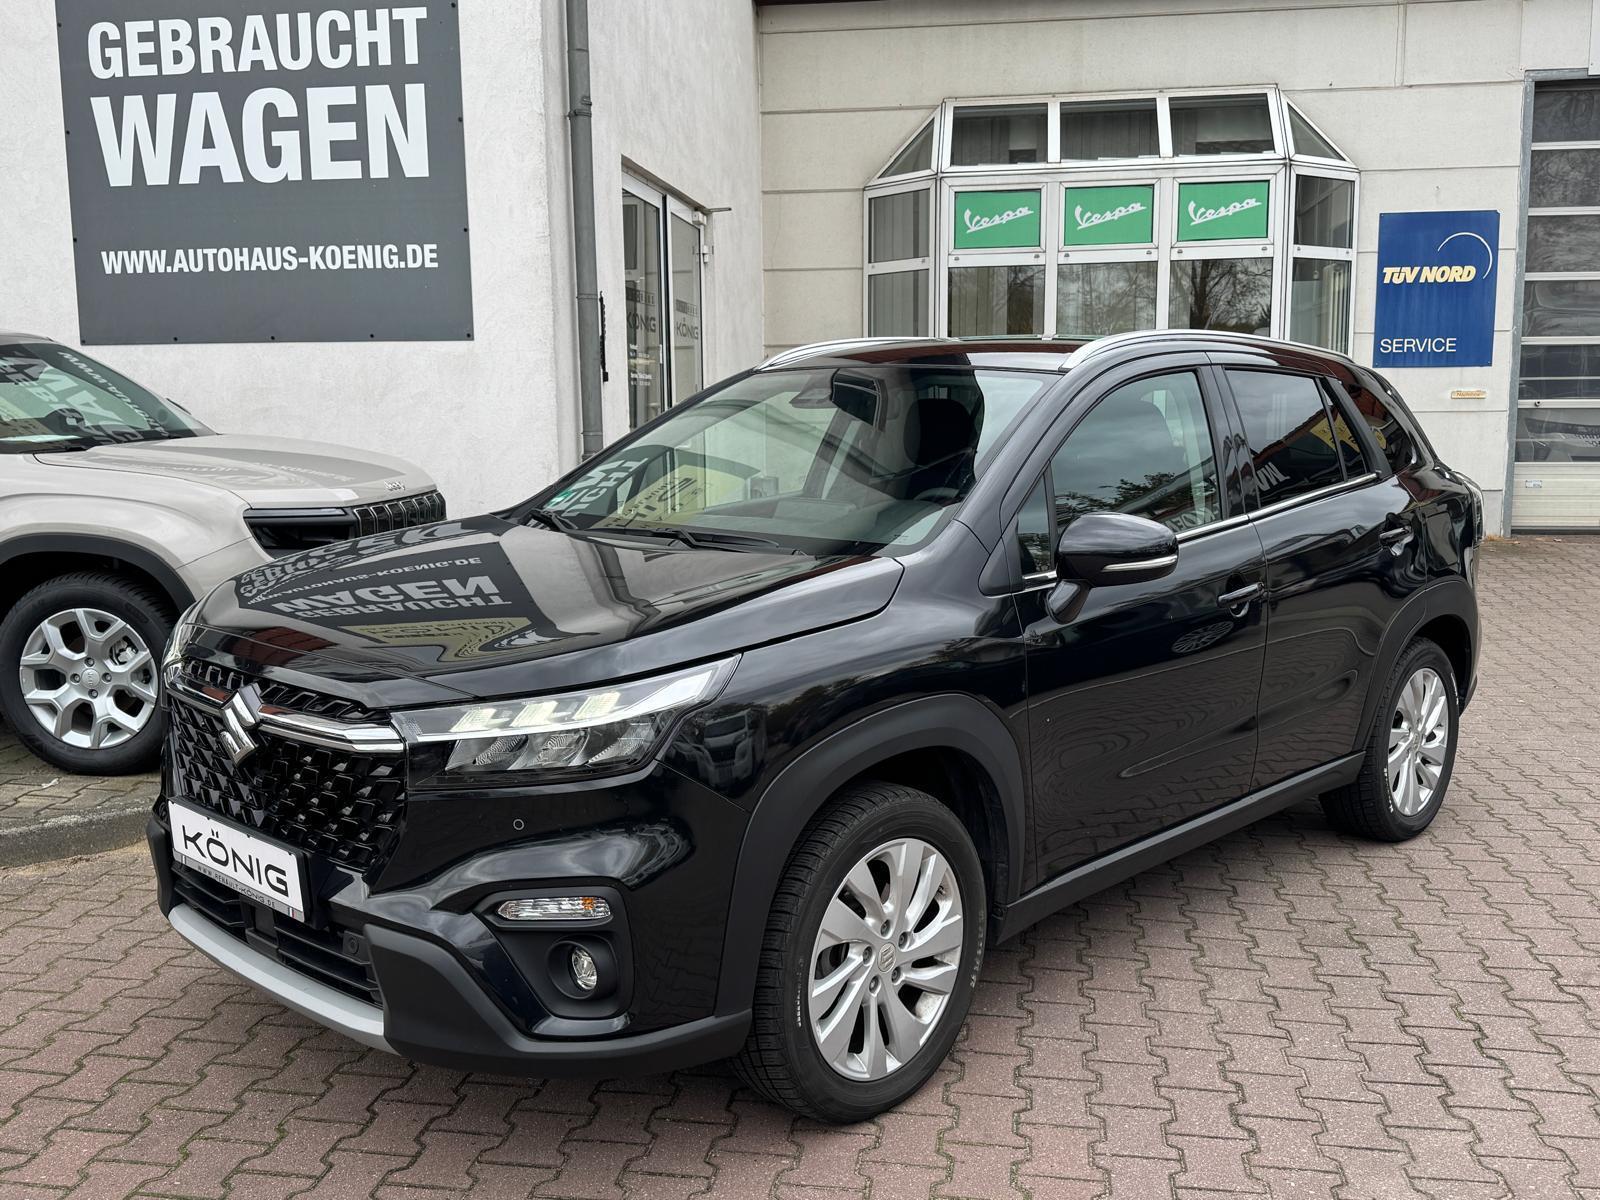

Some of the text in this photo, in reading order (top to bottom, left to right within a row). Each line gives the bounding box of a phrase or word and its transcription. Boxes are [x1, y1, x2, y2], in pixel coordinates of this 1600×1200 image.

[87, 6, 428, 80] GEBRAUCHT
[89, 83, 430, 187] WAGEN
[964, 206, 1034, 234] Vespa
[1074, 201, 1147, 231] Vespa
[1188, 197, 1263, 226] Vespa
[100, 243, 439, 275] WWW.AUTOHAUS-KOENIG.DE
[1382, 265, 1477, 284] TÜV NORD
[1379, 337, 1457, 353] SERVICE
[181, 825, 290, 898] KÖNIG
